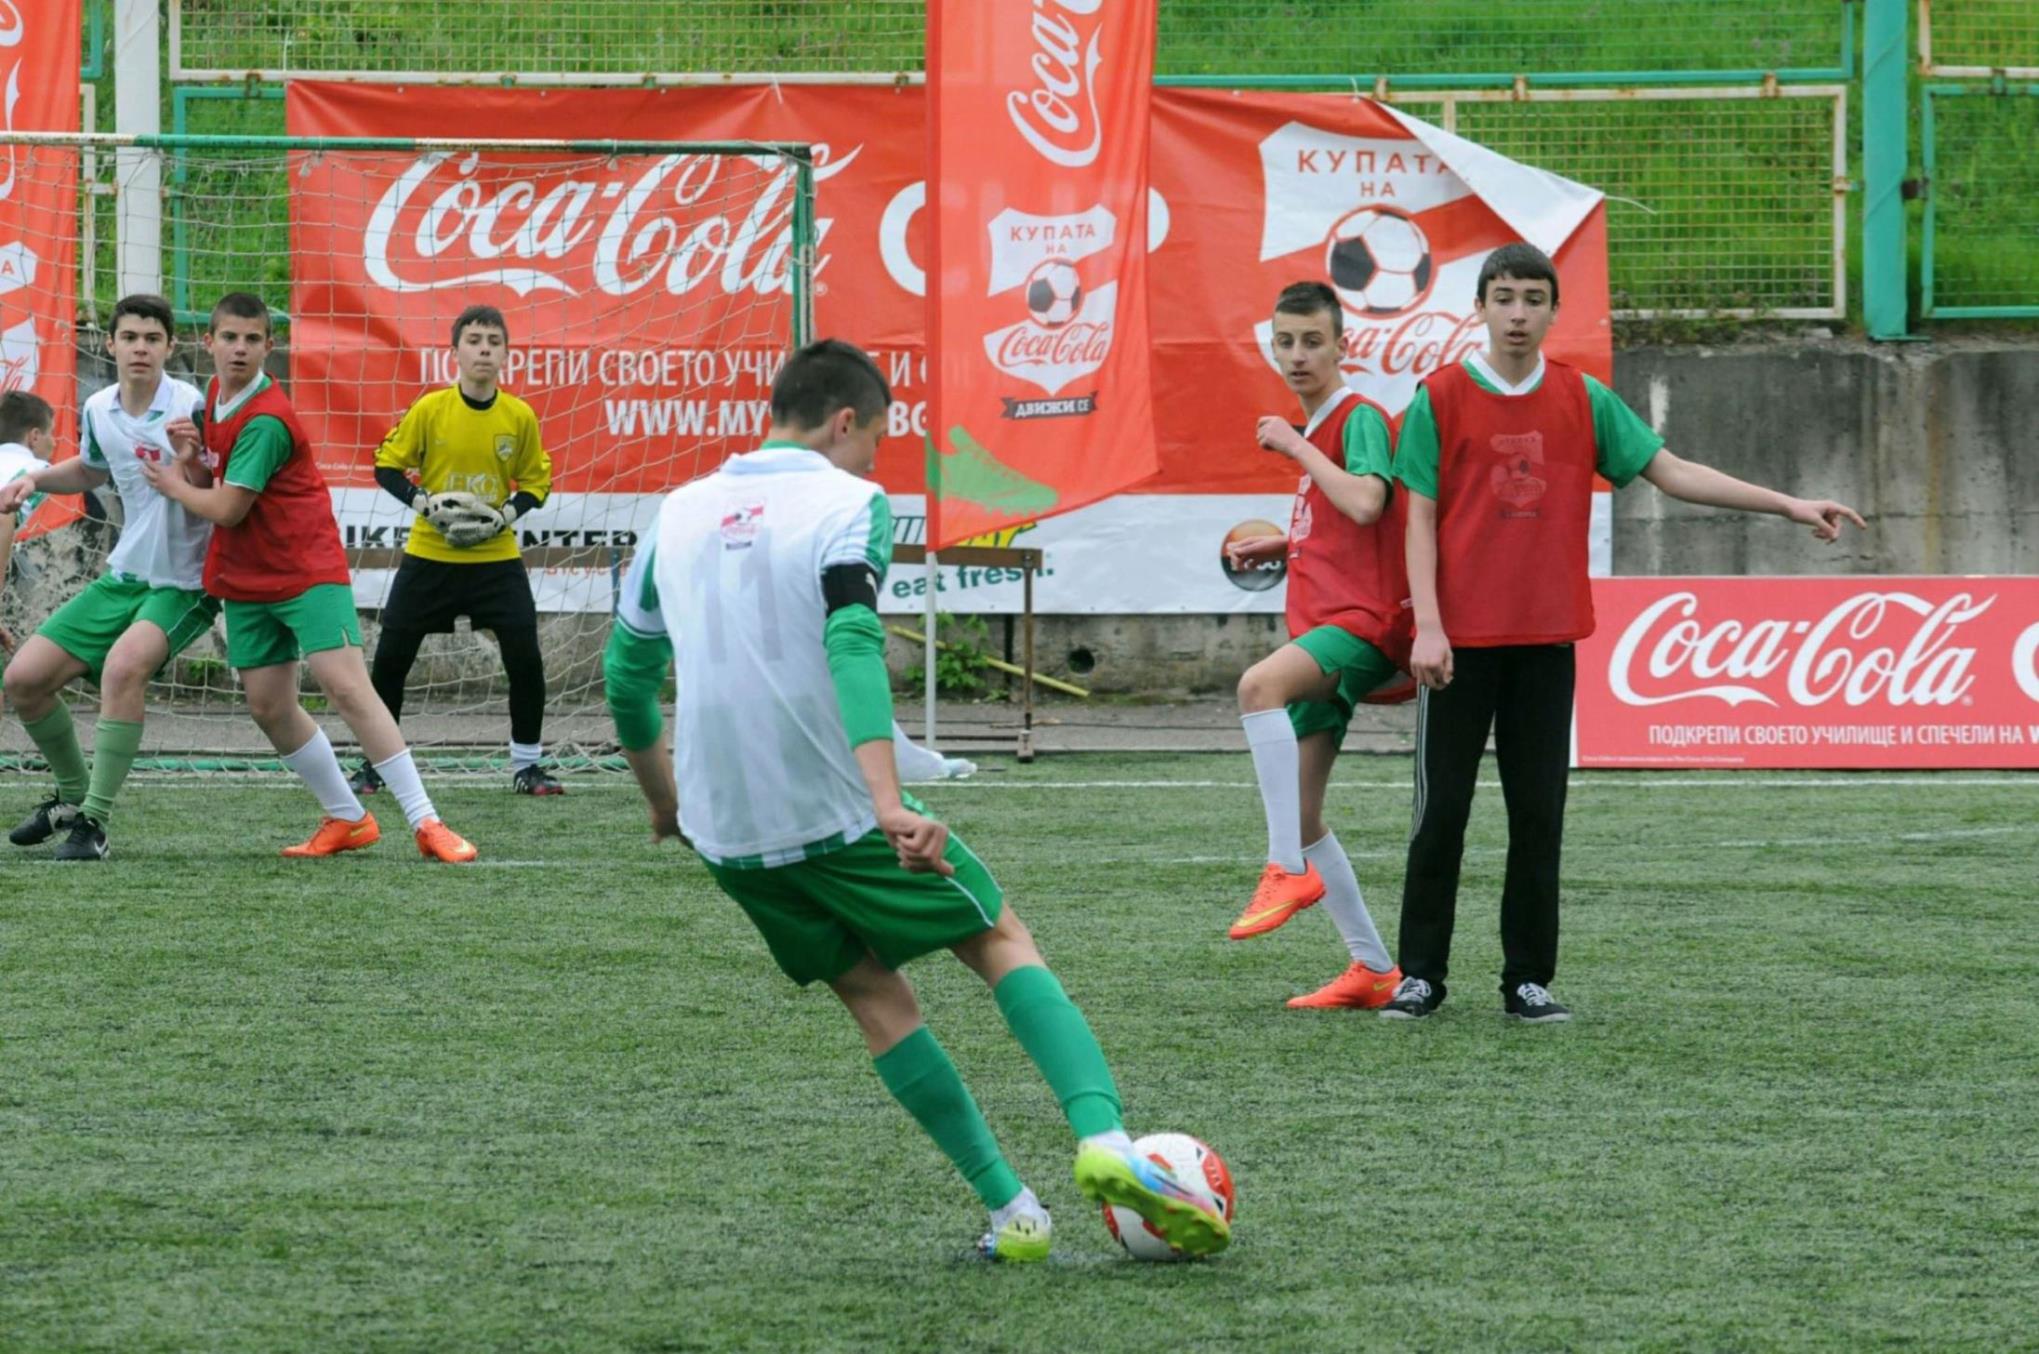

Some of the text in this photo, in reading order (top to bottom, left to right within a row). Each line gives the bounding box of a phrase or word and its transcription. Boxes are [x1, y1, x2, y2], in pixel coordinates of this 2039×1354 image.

[1360, 181, 1396, 197] НА
[364, 140, 864, 297] Coca-Cola
[1010, 224, 1096, 242] КУПАТА
[1045, 243, 1067, 254] НА
[998, 321, 1110, 368] Coca-Cola
[419, 347, 589, 386] ПОРЕПИ
[600, 350, 717, 387] СВОЕТО
[890, 351, 911, 388] И
[1015, 399, 1075, 417] ДВИЖИ
[346, 526, 411, 547] IKE
[892, 570, 947, 599] eat
[1608, 591, 1998, 708] Coca-Cola
[1649, 724, 1741, 747] ПОДКРЕПИ
[1744, 724, 1808, 745] СВОЕТО
[1811, 724, 1897, 748] УЧИЛИЩЕ
[1901, 724, 1913, 745] И
[1917, 724, 1995, 745] СПЕЧЕЛИ
[1999, 724, 2025, 745] НА
